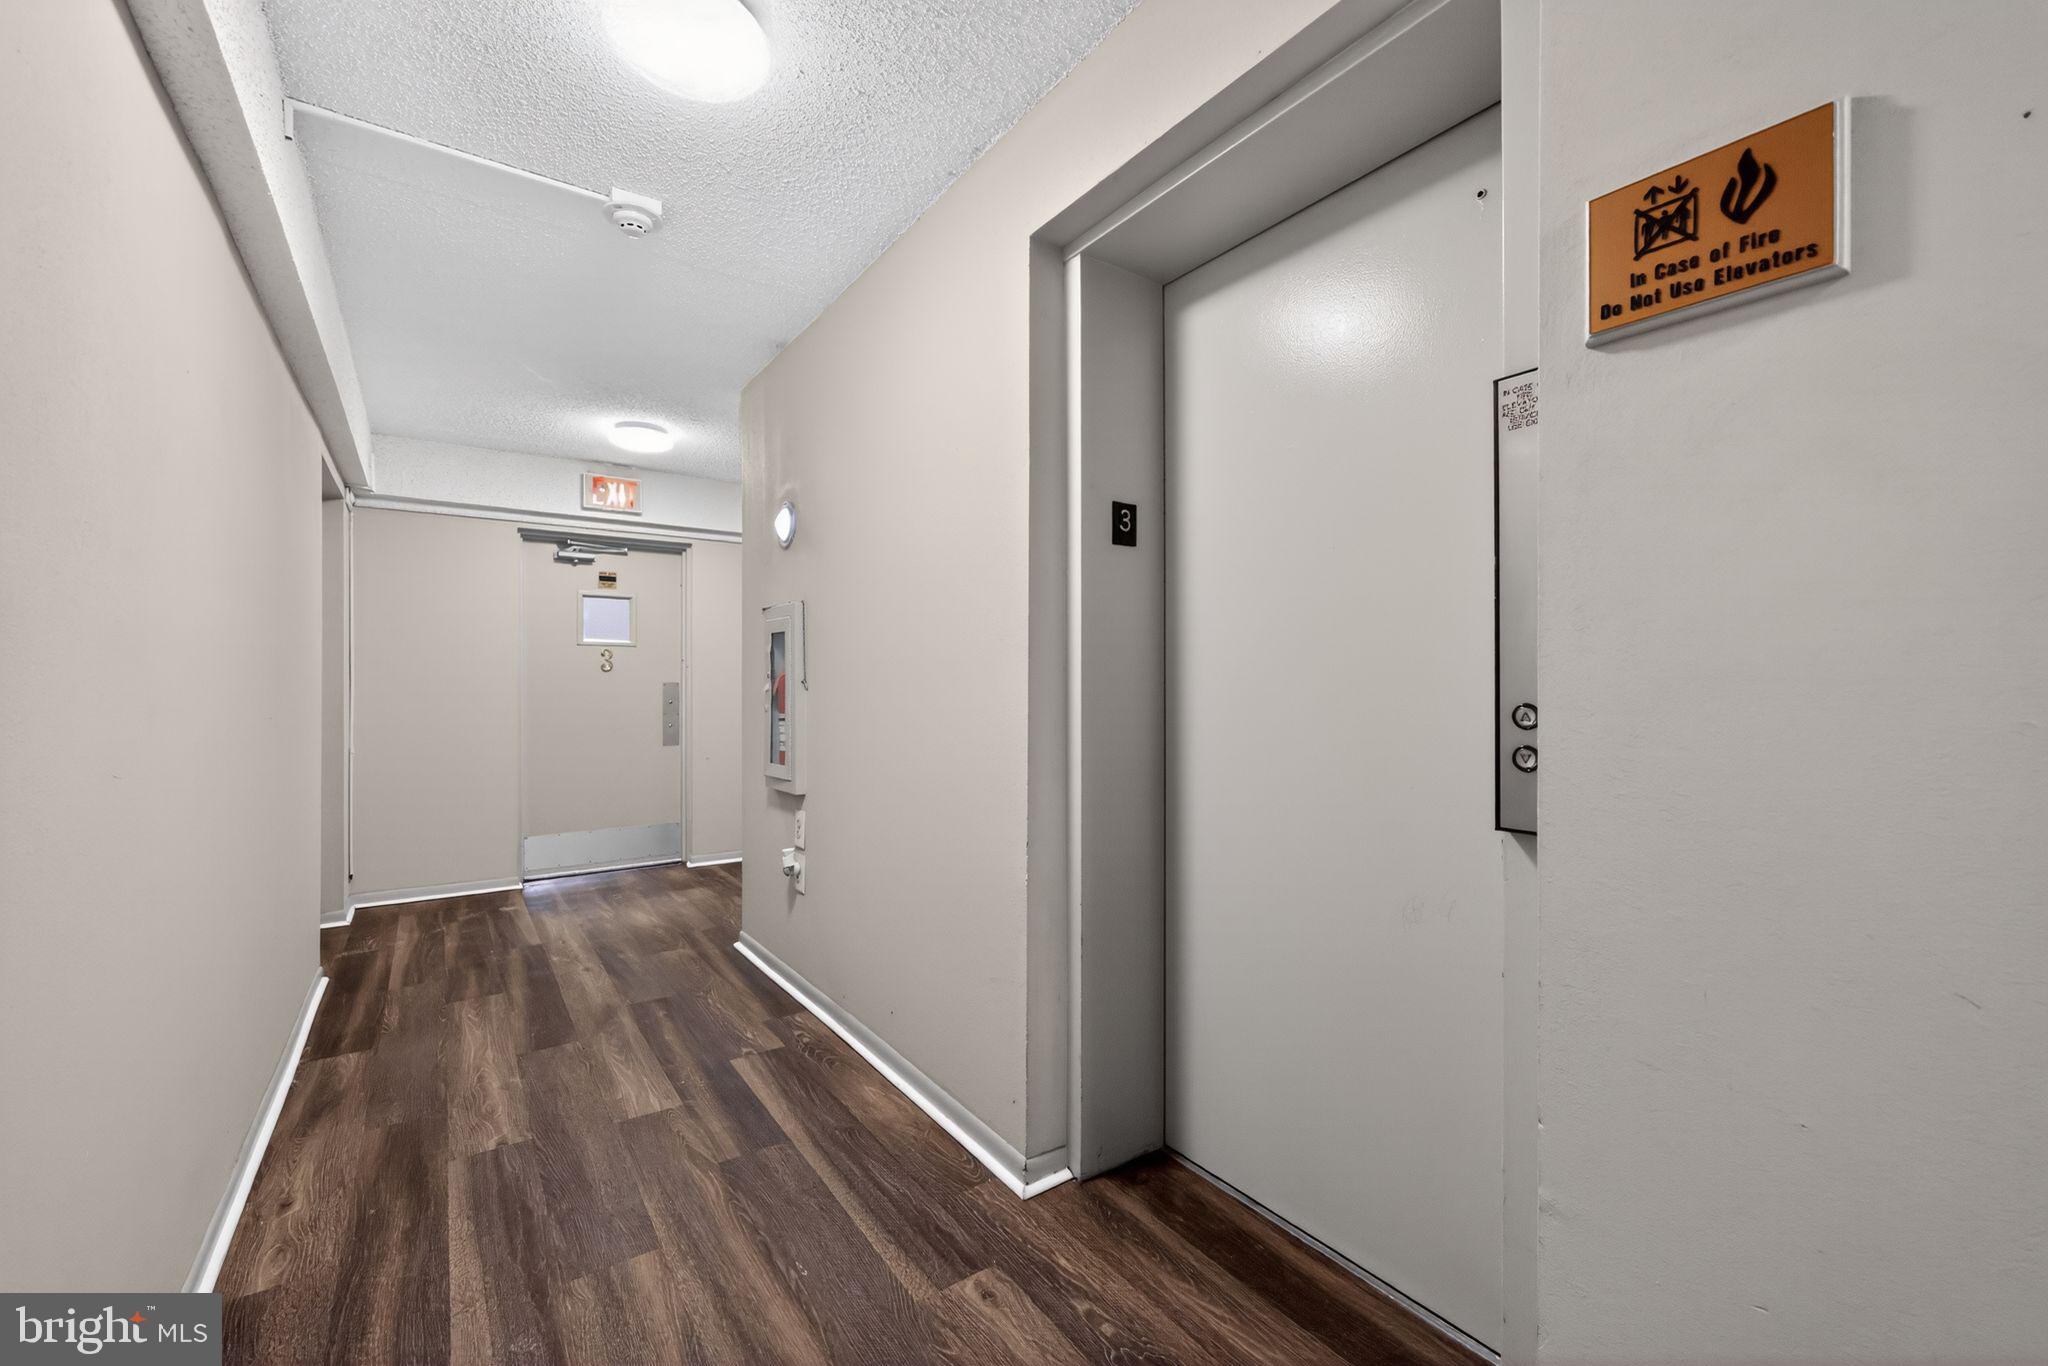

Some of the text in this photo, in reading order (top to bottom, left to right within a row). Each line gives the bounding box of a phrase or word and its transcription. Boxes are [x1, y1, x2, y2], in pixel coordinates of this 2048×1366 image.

[1630, 228, 1781, 289] In Case of Fire
[1600, 242, 1819, 321] Do Not Use Elevators
[1119, 509, 1132, 533] 3
[600, 648, 614, 673] 3
